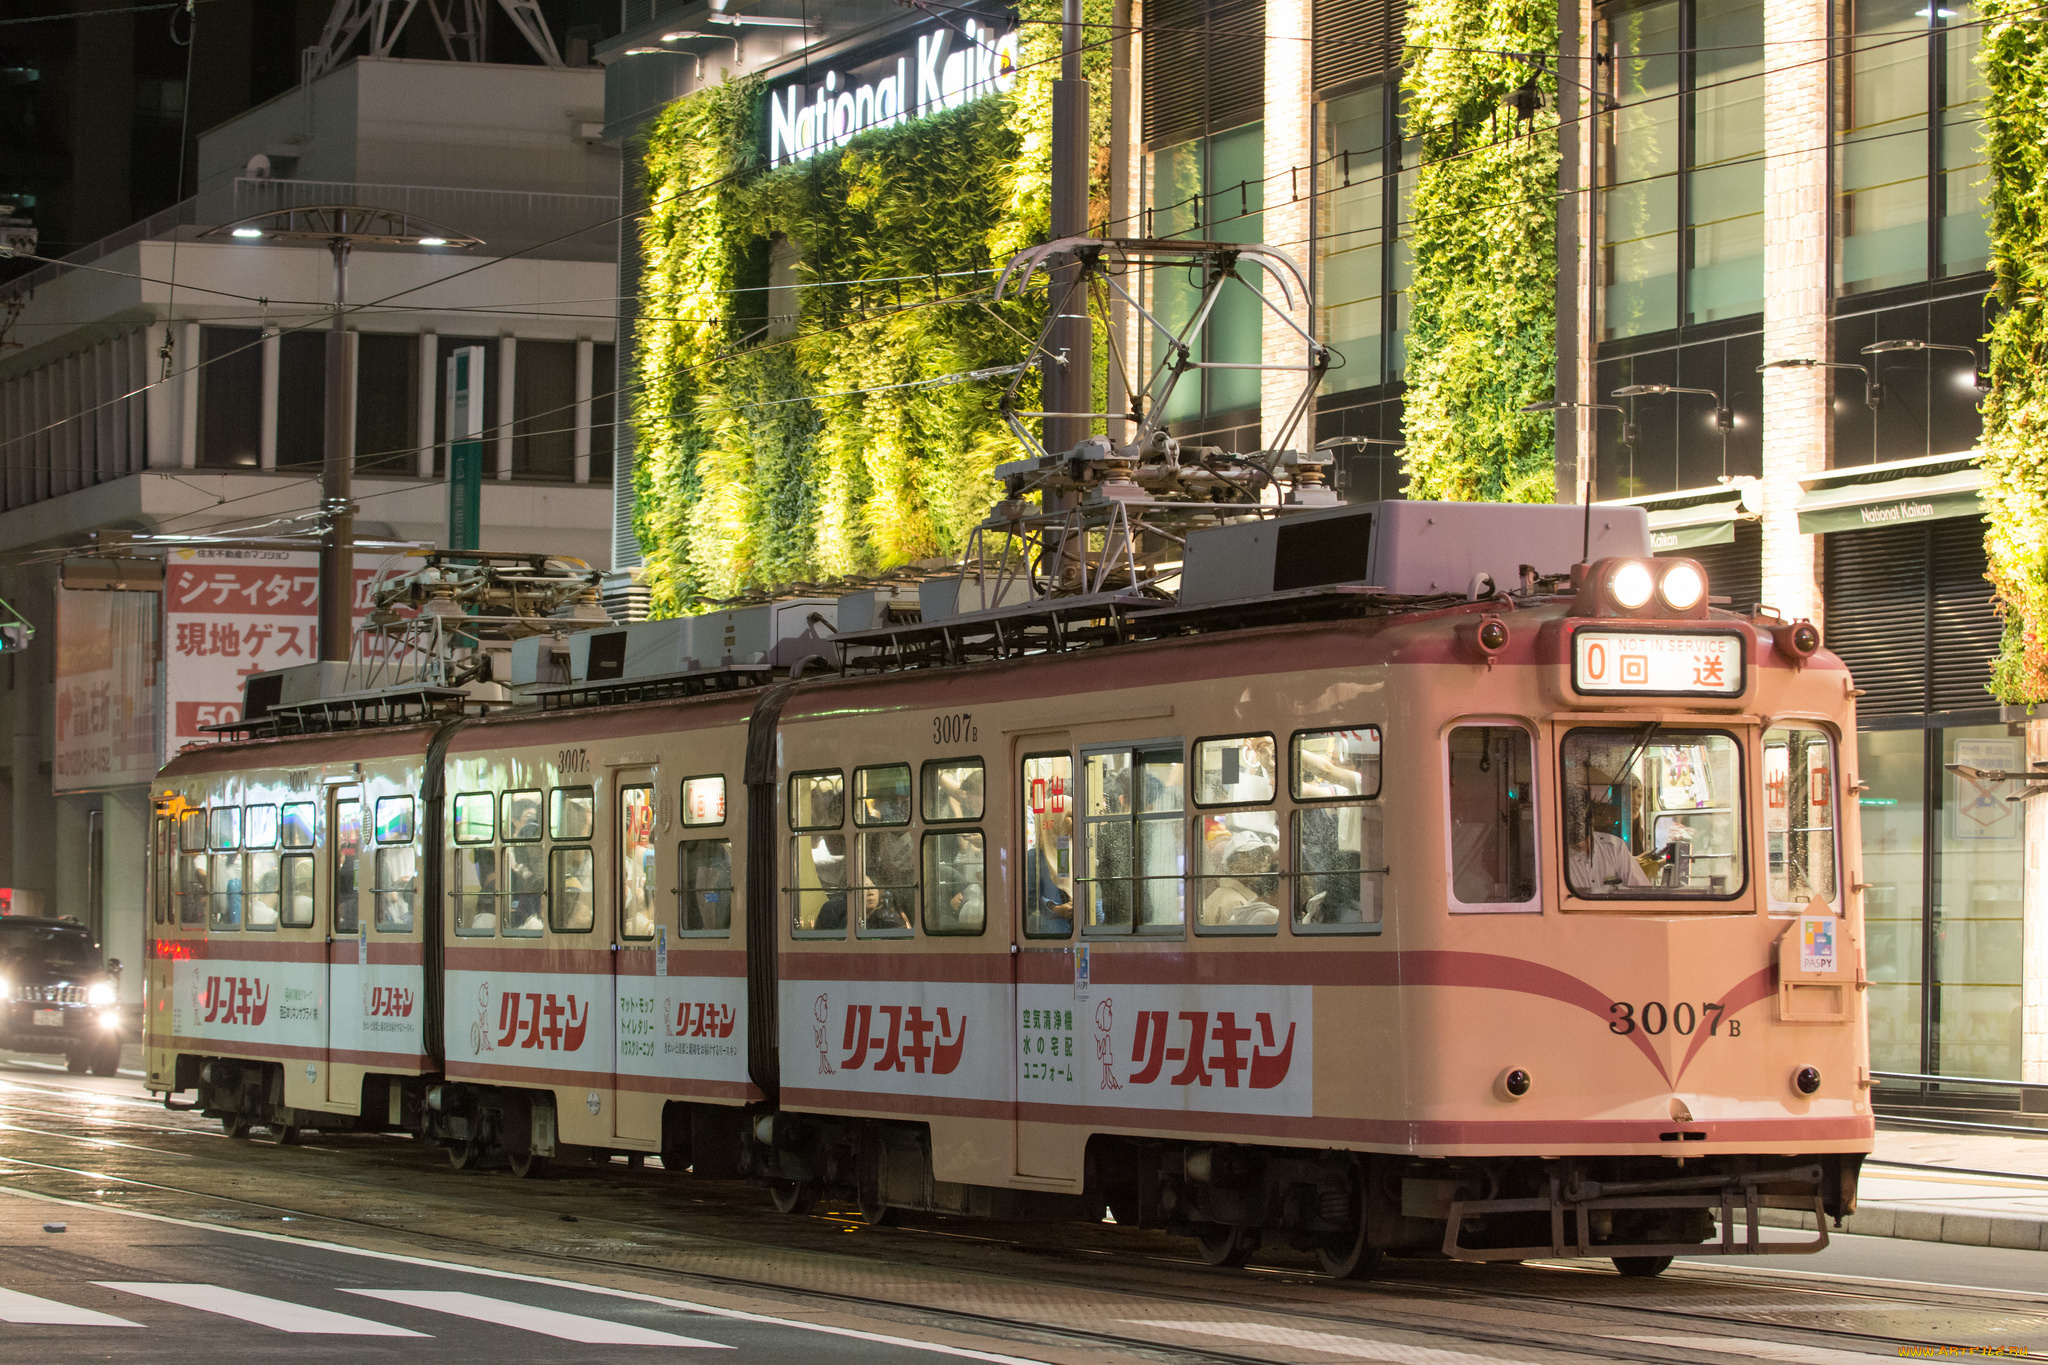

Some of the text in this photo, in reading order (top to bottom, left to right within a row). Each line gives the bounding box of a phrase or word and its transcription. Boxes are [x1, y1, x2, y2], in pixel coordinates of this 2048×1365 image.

[770, 18, 1018, 170] National Kaika
[1860, 502, 1933, 524] National Kaikan
[1650, 533, 1678, 548] Kaikan
[197, 549, 289, 560] 住友不動産のマンション
[1618, 639, 1726, 652] NOT IN SERVICE
[1588, 643, 1605, 680] 0
[1804, 958, 1833, 969] PASPY
[204, 976, 270, 1026] リースキン
[371, 987, 415, 1018] リースキン
[497, 992, 589, 1052] リースキン
[620, 1019, 654, 1036] トイレタリー
[675, 1002, 736, 1038] リースキン
[1022, 1009, 1073, 1032] 空気清浄機
[841, 1004, 967, 1075] リースキン
[1022, 1035, 1073, 1057] 水の宅配
[1129, 1010, 1296, 1089] リースキン
[1022, 1062, 1073, 1083] ユニフォーム
